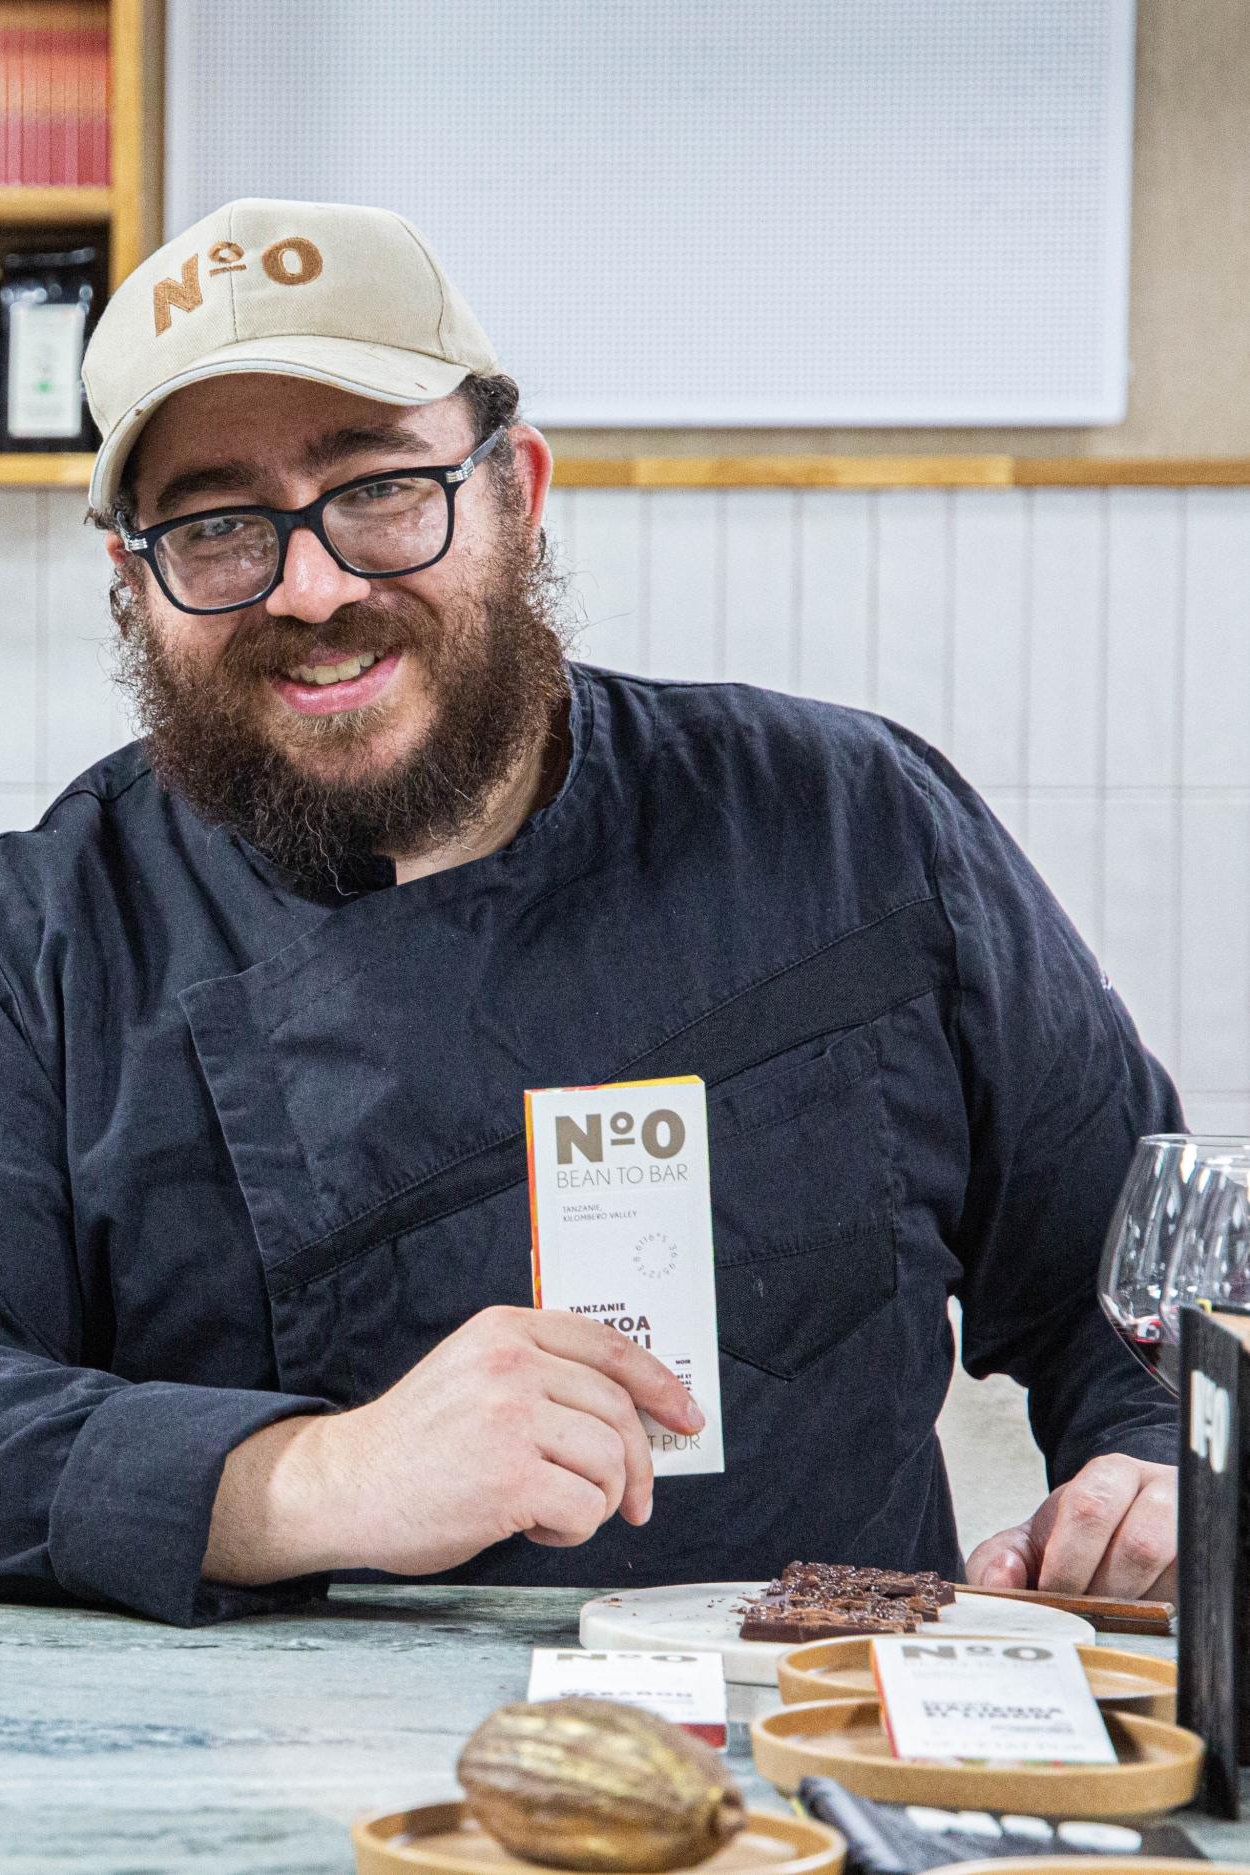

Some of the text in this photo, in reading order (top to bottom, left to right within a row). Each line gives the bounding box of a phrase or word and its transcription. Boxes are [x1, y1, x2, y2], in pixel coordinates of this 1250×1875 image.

[556, 1163, 688, 1189] BEAN TO BAR
[610, 1210, 638, 1219] VALLEY
[569, 1302, 626, 1314] TANZANIE
[661, 1433, 702, 1452] PUR
